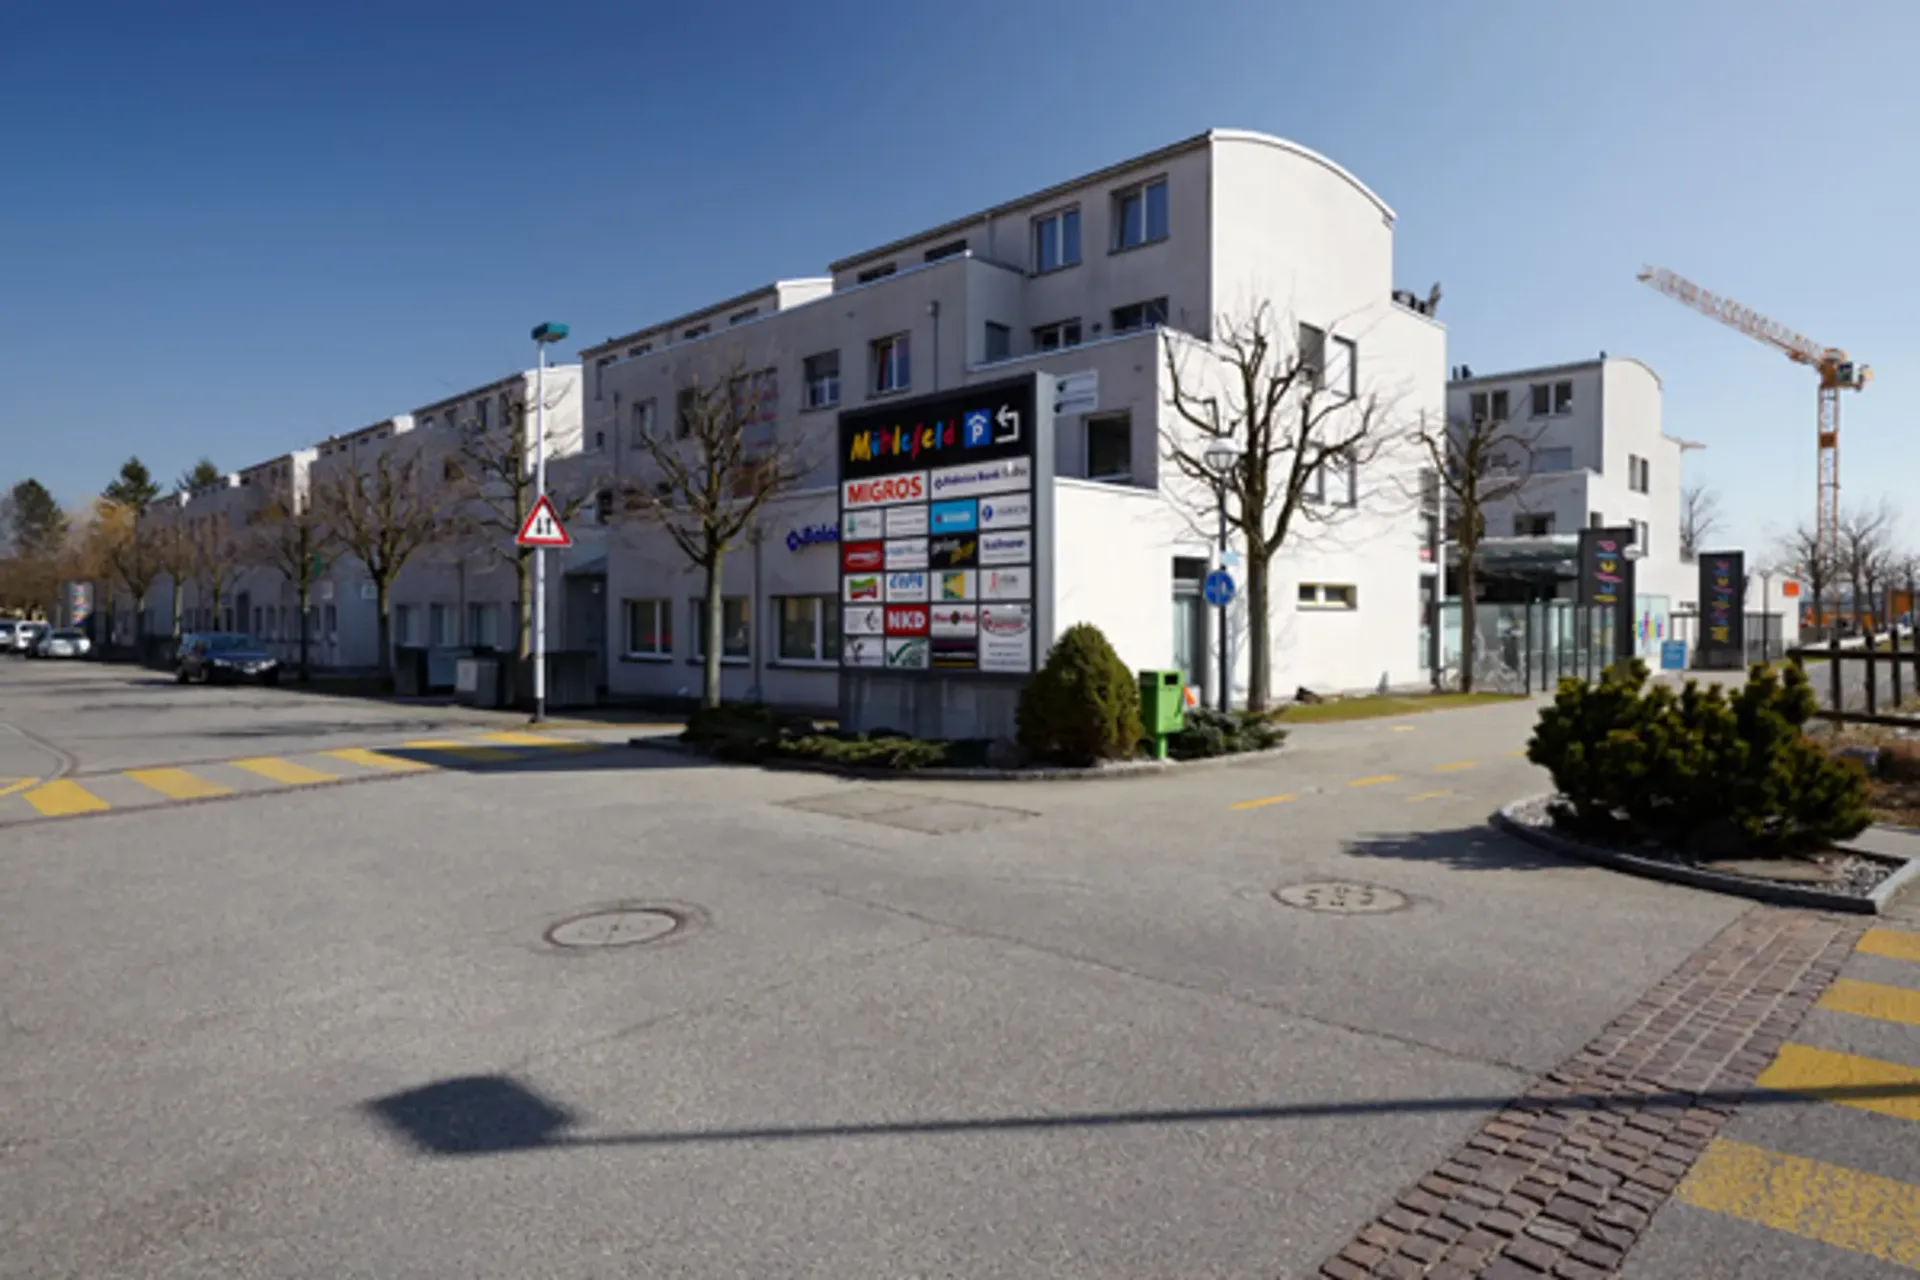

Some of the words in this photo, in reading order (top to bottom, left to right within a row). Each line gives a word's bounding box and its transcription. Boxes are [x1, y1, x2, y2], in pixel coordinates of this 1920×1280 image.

[850, 419, 955, 462] Mühlefeld
[848, 476, 922, 503] MIGROS
[887, 610, 926, 630] NKD
